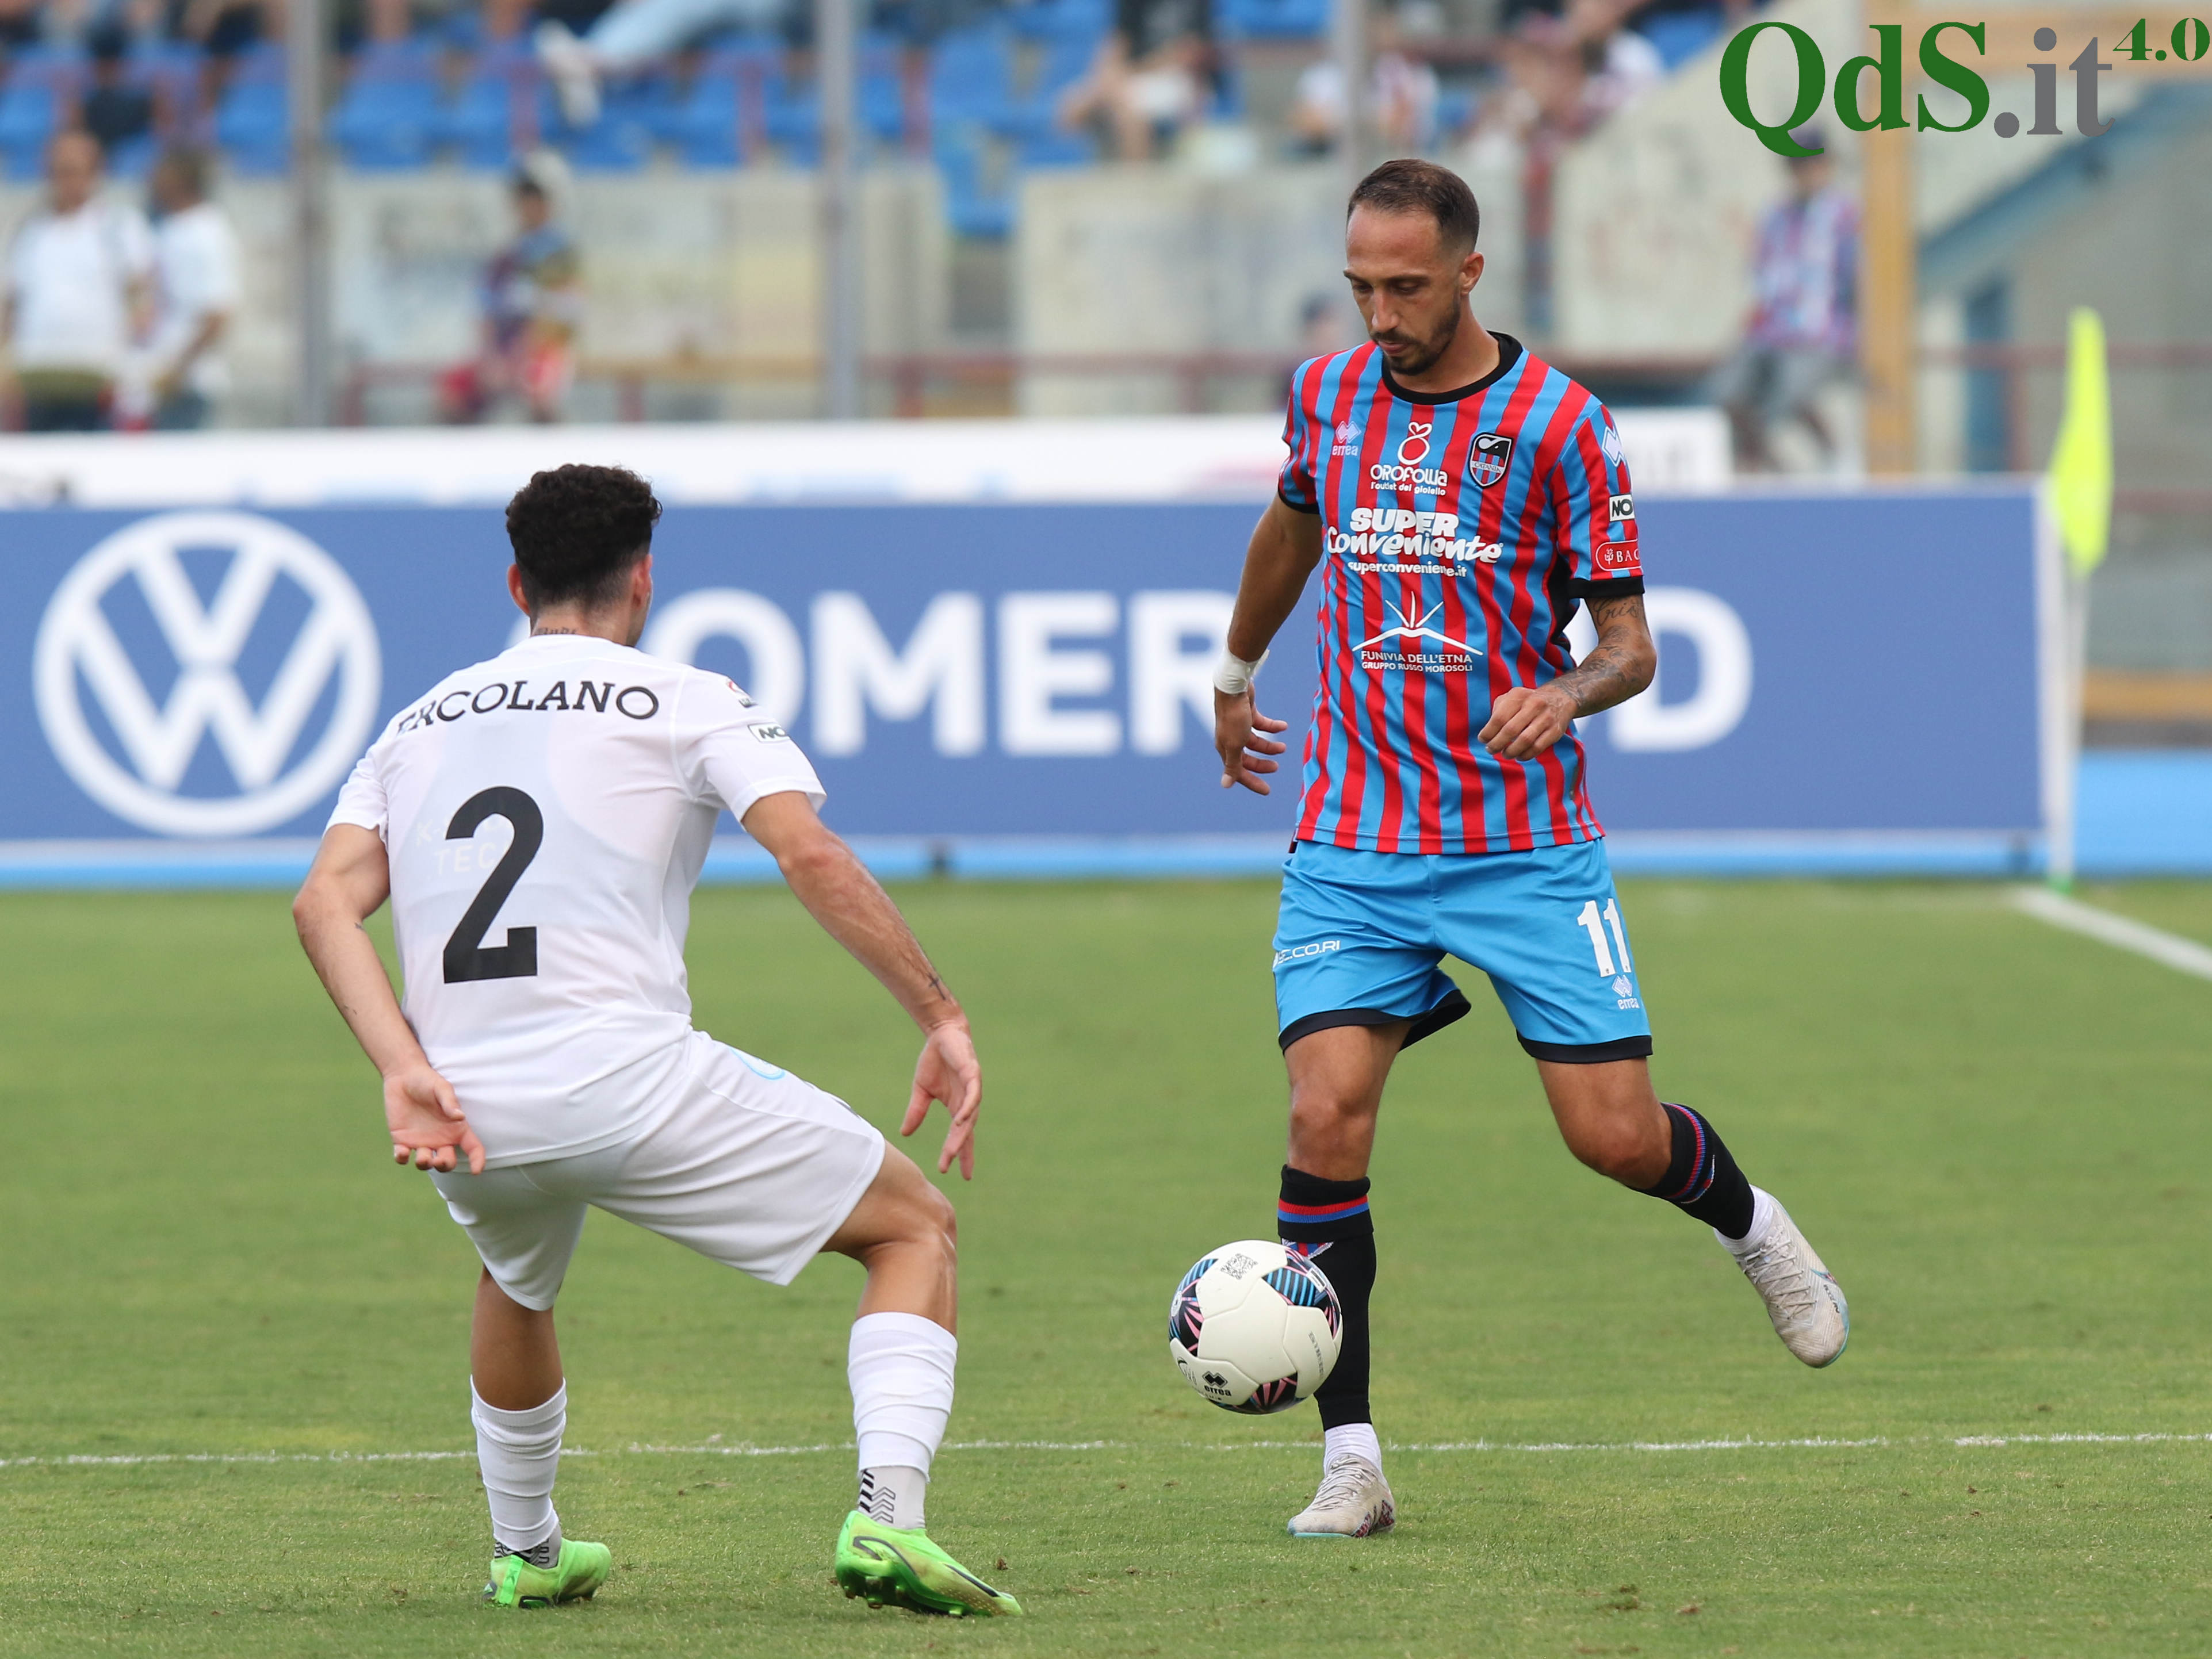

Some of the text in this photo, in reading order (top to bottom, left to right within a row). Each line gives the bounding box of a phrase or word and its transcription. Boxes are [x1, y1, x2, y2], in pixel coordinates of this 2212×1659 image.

[1349, 507, 1459, 537] SUPER
[1327, 526, 1502, 564] Conveniente
[506, 584, 1277, 757] OMER
[1360, 650, 1473, 664] FUNIVIA DELL'ETNA
[1361, 662, 1473, 673] GRUPPO RUSSO MOROSOLI
[443, 786, 544, 984] 2
[1577, 898, 1632, 977] 11
